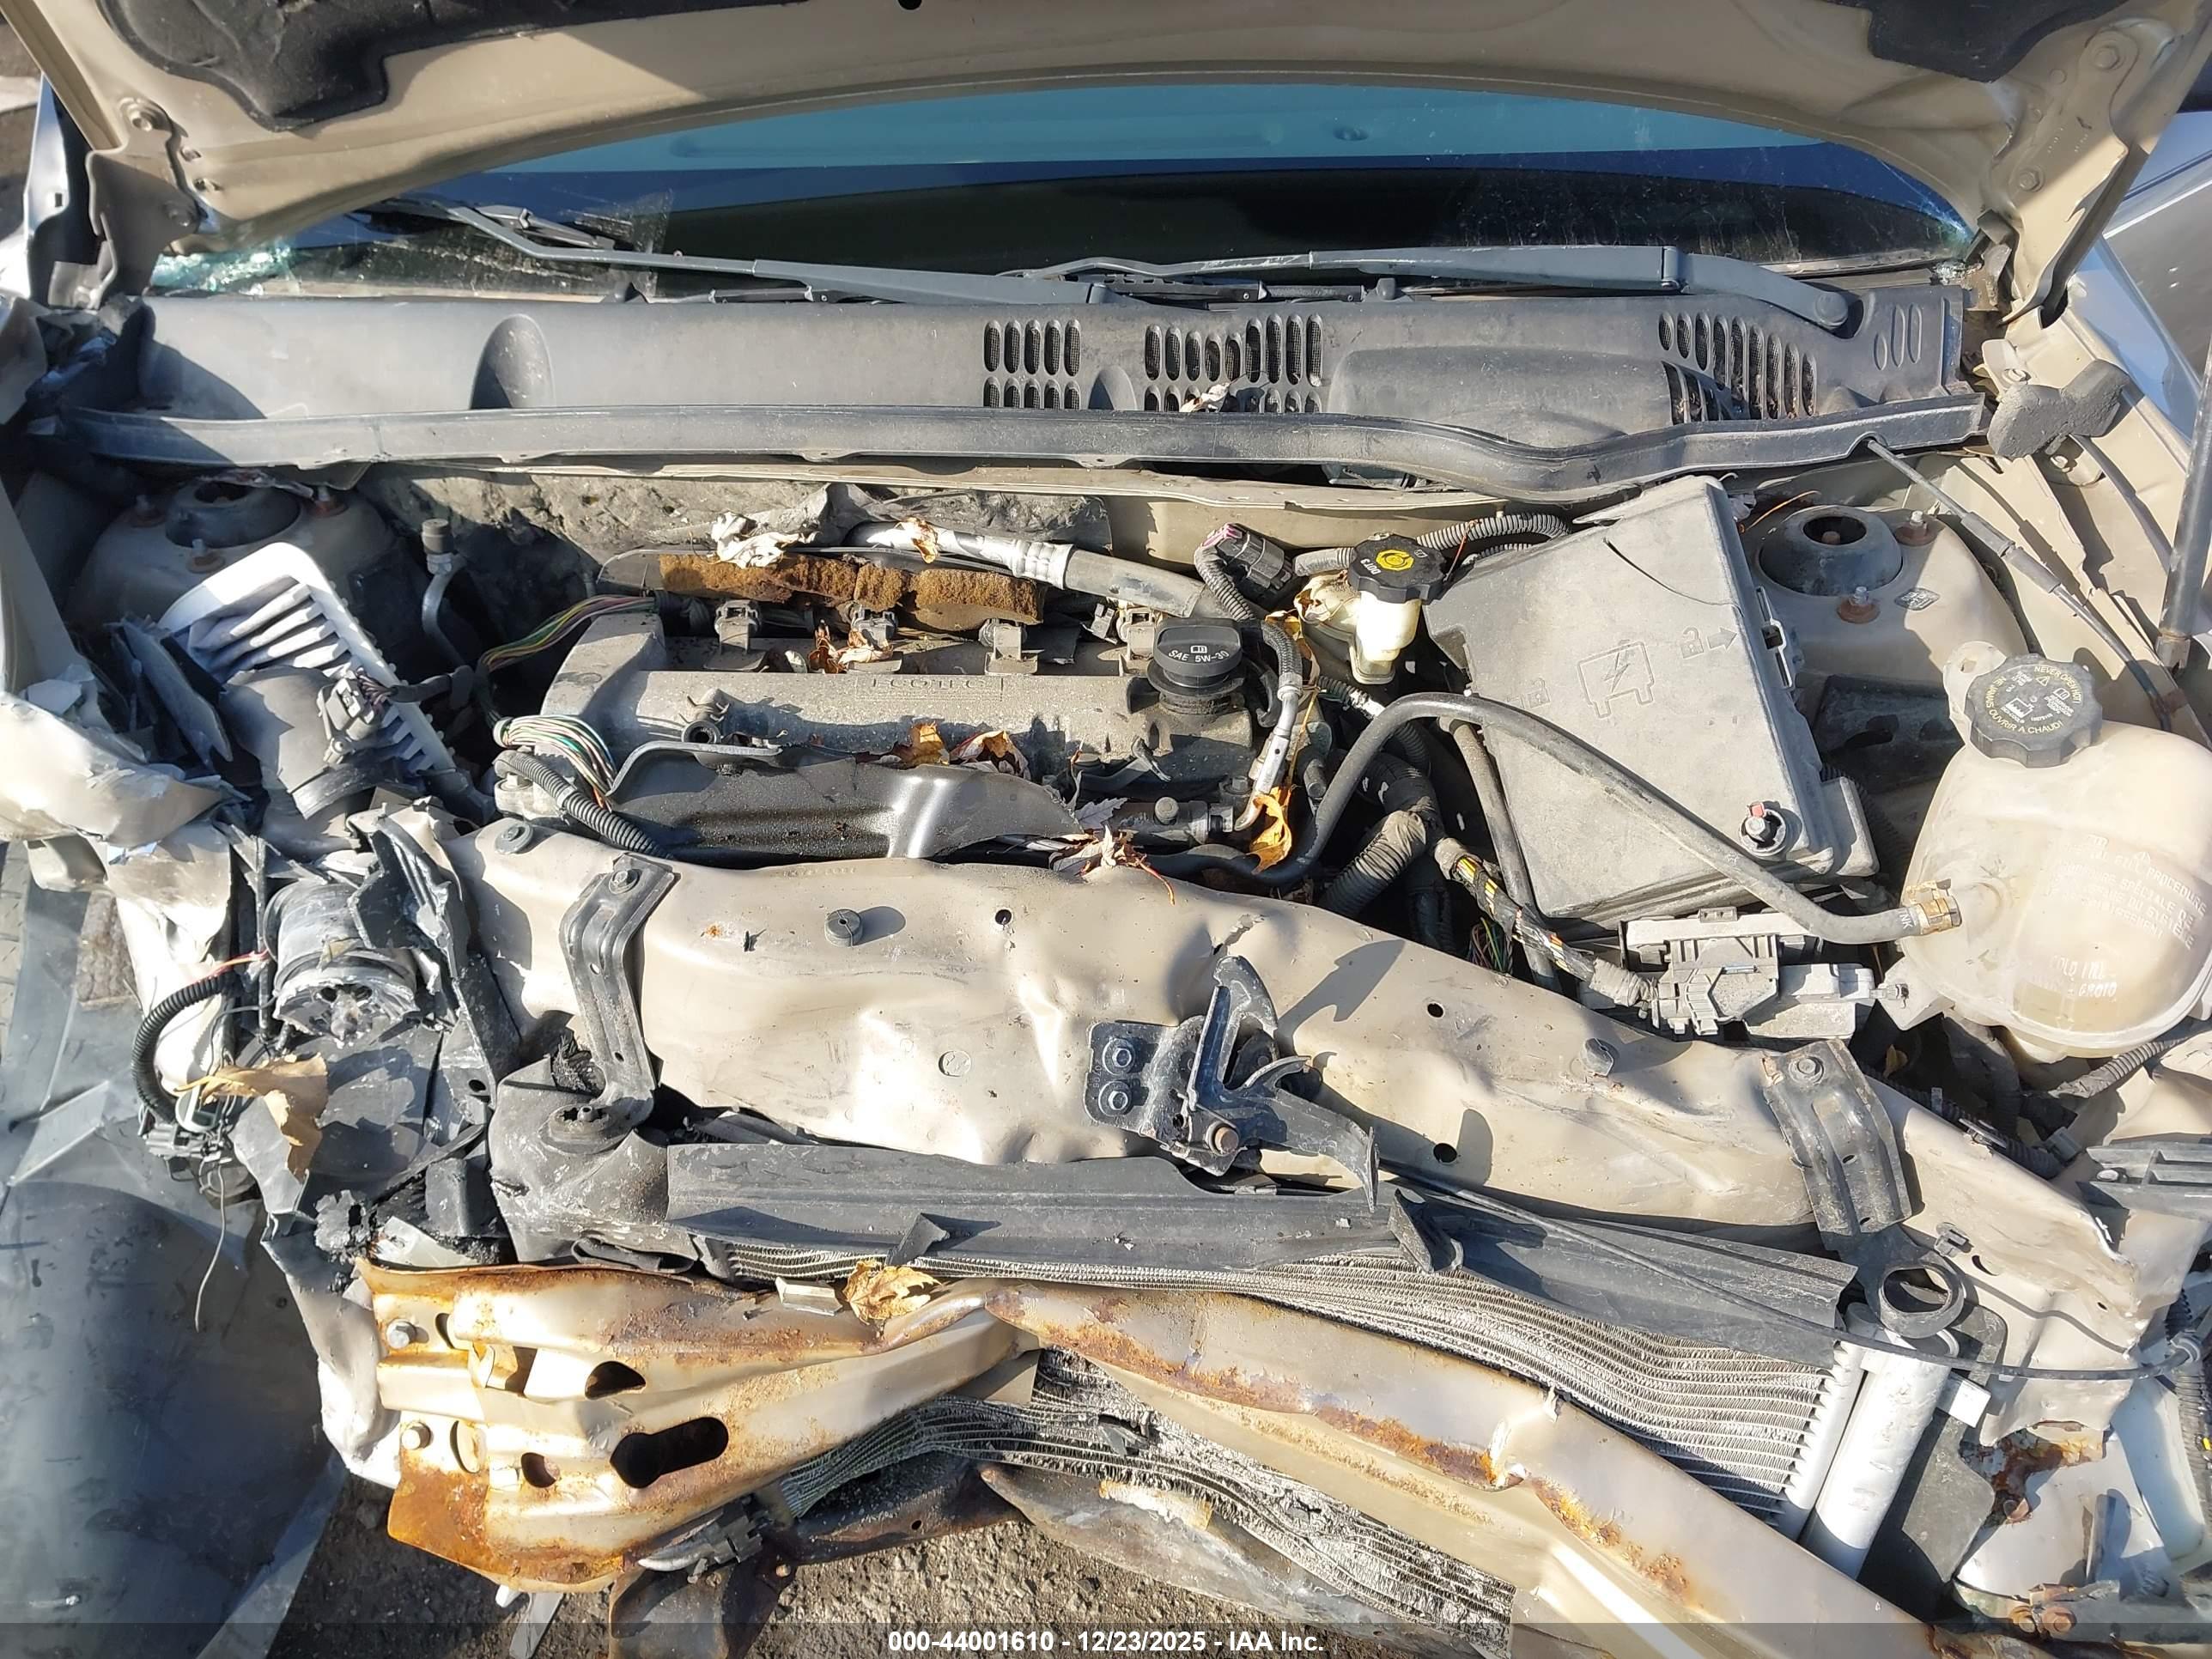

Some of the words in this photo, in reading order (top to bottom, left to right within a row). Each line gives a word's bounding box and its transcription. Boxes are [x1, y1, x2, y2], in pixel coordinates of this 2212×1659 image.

[1360, 558, 1382, 574] DOT3
[1168, 650, 1189, 661] SAE
[1194, 650, 1230, 662] 5W-30
[2034, 665, 2062, 678] NEVER
[1989, 709, 2017, 731] OUVRIR
